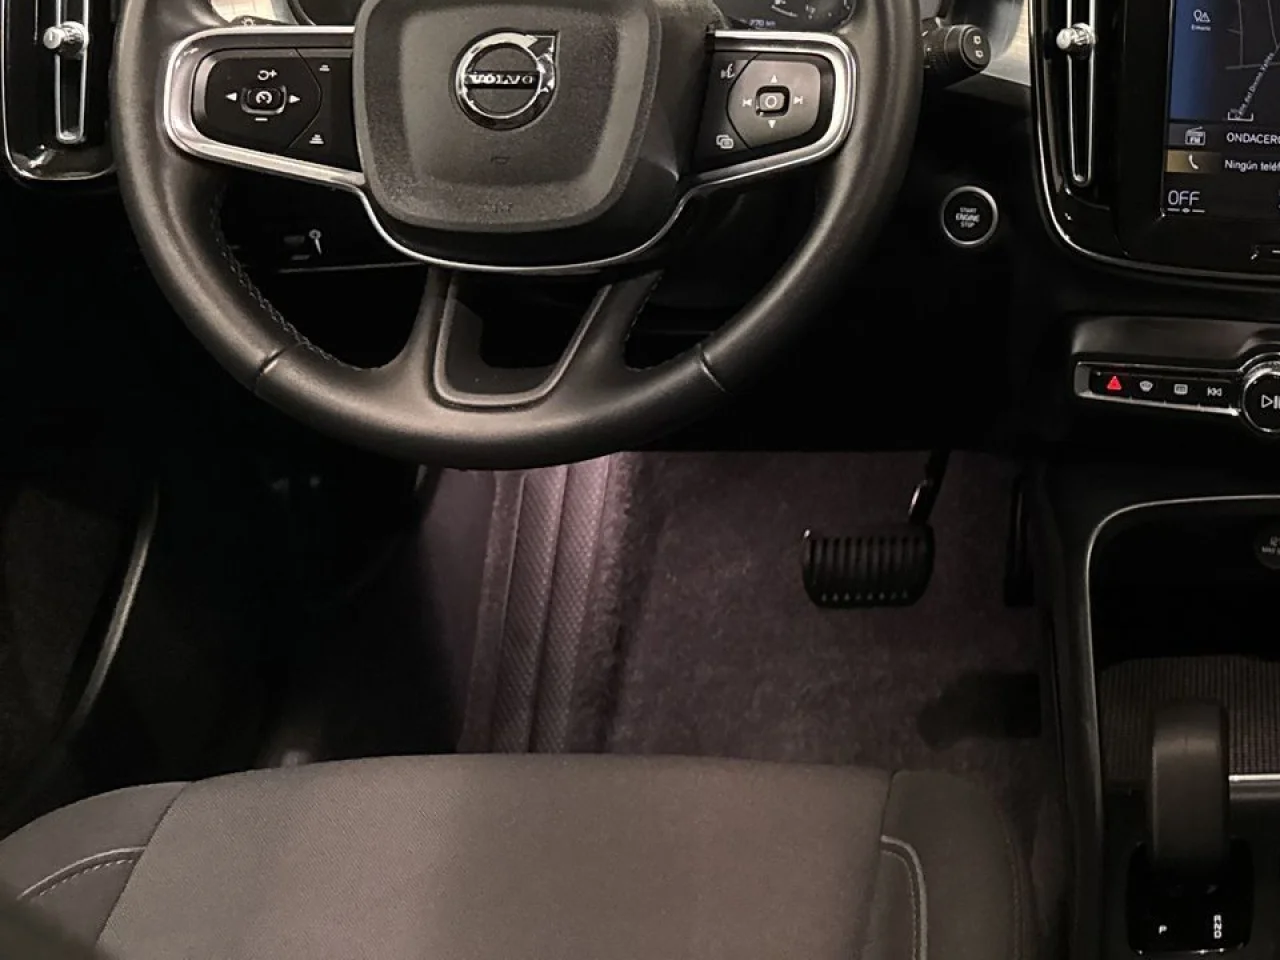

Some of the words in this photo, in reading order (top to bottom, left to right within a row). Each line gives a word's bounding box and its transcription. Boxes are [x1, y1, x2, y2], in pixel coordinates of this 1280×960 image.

[468, 73, 533, 85] VOLVO
[1224, 159, 1258, 173] Ningún
[1167, 190, 1201, 206] OFF
